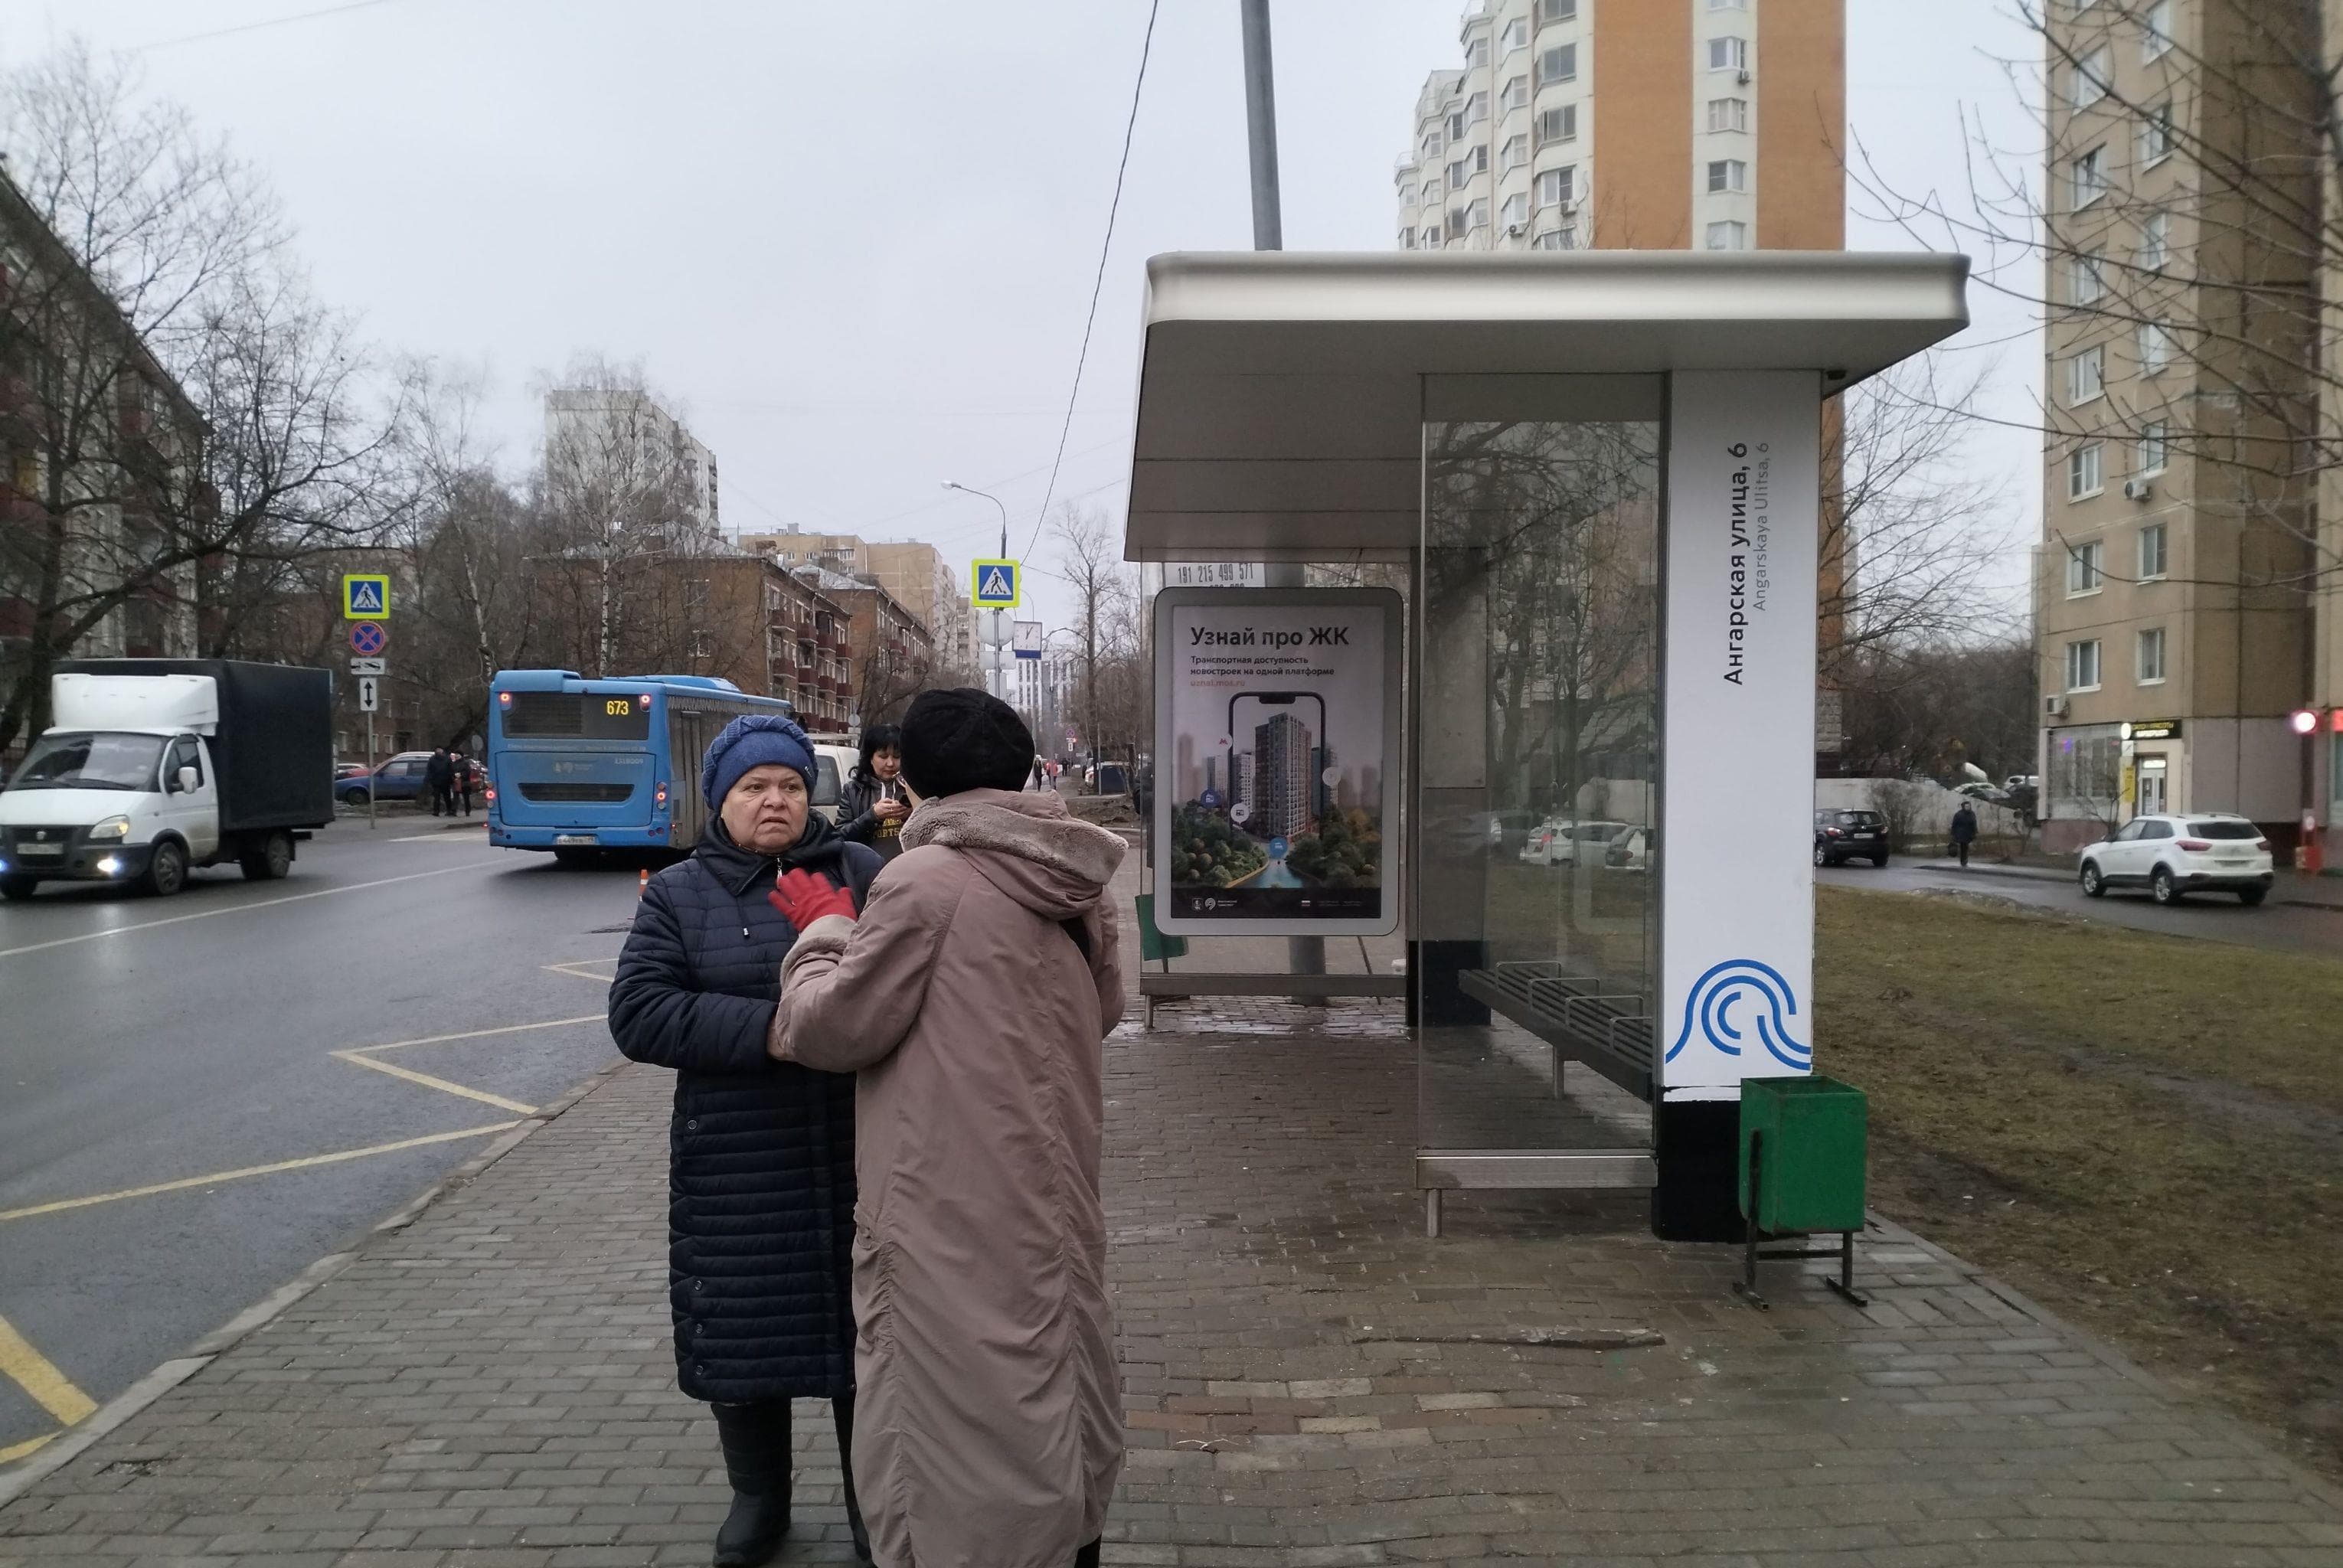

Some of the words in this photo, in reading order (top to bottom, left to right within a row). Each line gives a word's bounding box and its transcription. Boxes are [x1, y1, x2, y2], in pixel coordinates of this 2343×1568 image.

[1727, 442, 1747, 458] 6
[1755, 442, 1770, 453] 6
[1754, 458, 1771, 510] Ulitsa,
[1731, 465, 1751, 547] улица,
[1753, 515, 1771, 612] Angarskaya
[1178, 566, 1192, 583] 191
[1198, 564, 1214, 583] 215
[1218, 564, 1234, 581] 499
[1724, 555, 1749, 685] Ангарская
[1190, 626, 1256, 645] Узнай
[1262, 631, 1303, 649] про
[1309, 626, 1351, 645] ЖК
[1190, 655, 1252, 665] Транспортная
[1253, 657, 1309, 666] доступность
[1190, 668, 1242, 677] новостроек
[1256, 666, 1283, 677] одной
[1285, 668, 1335, 677] платформе
[606, 701, 629, 716] 673
